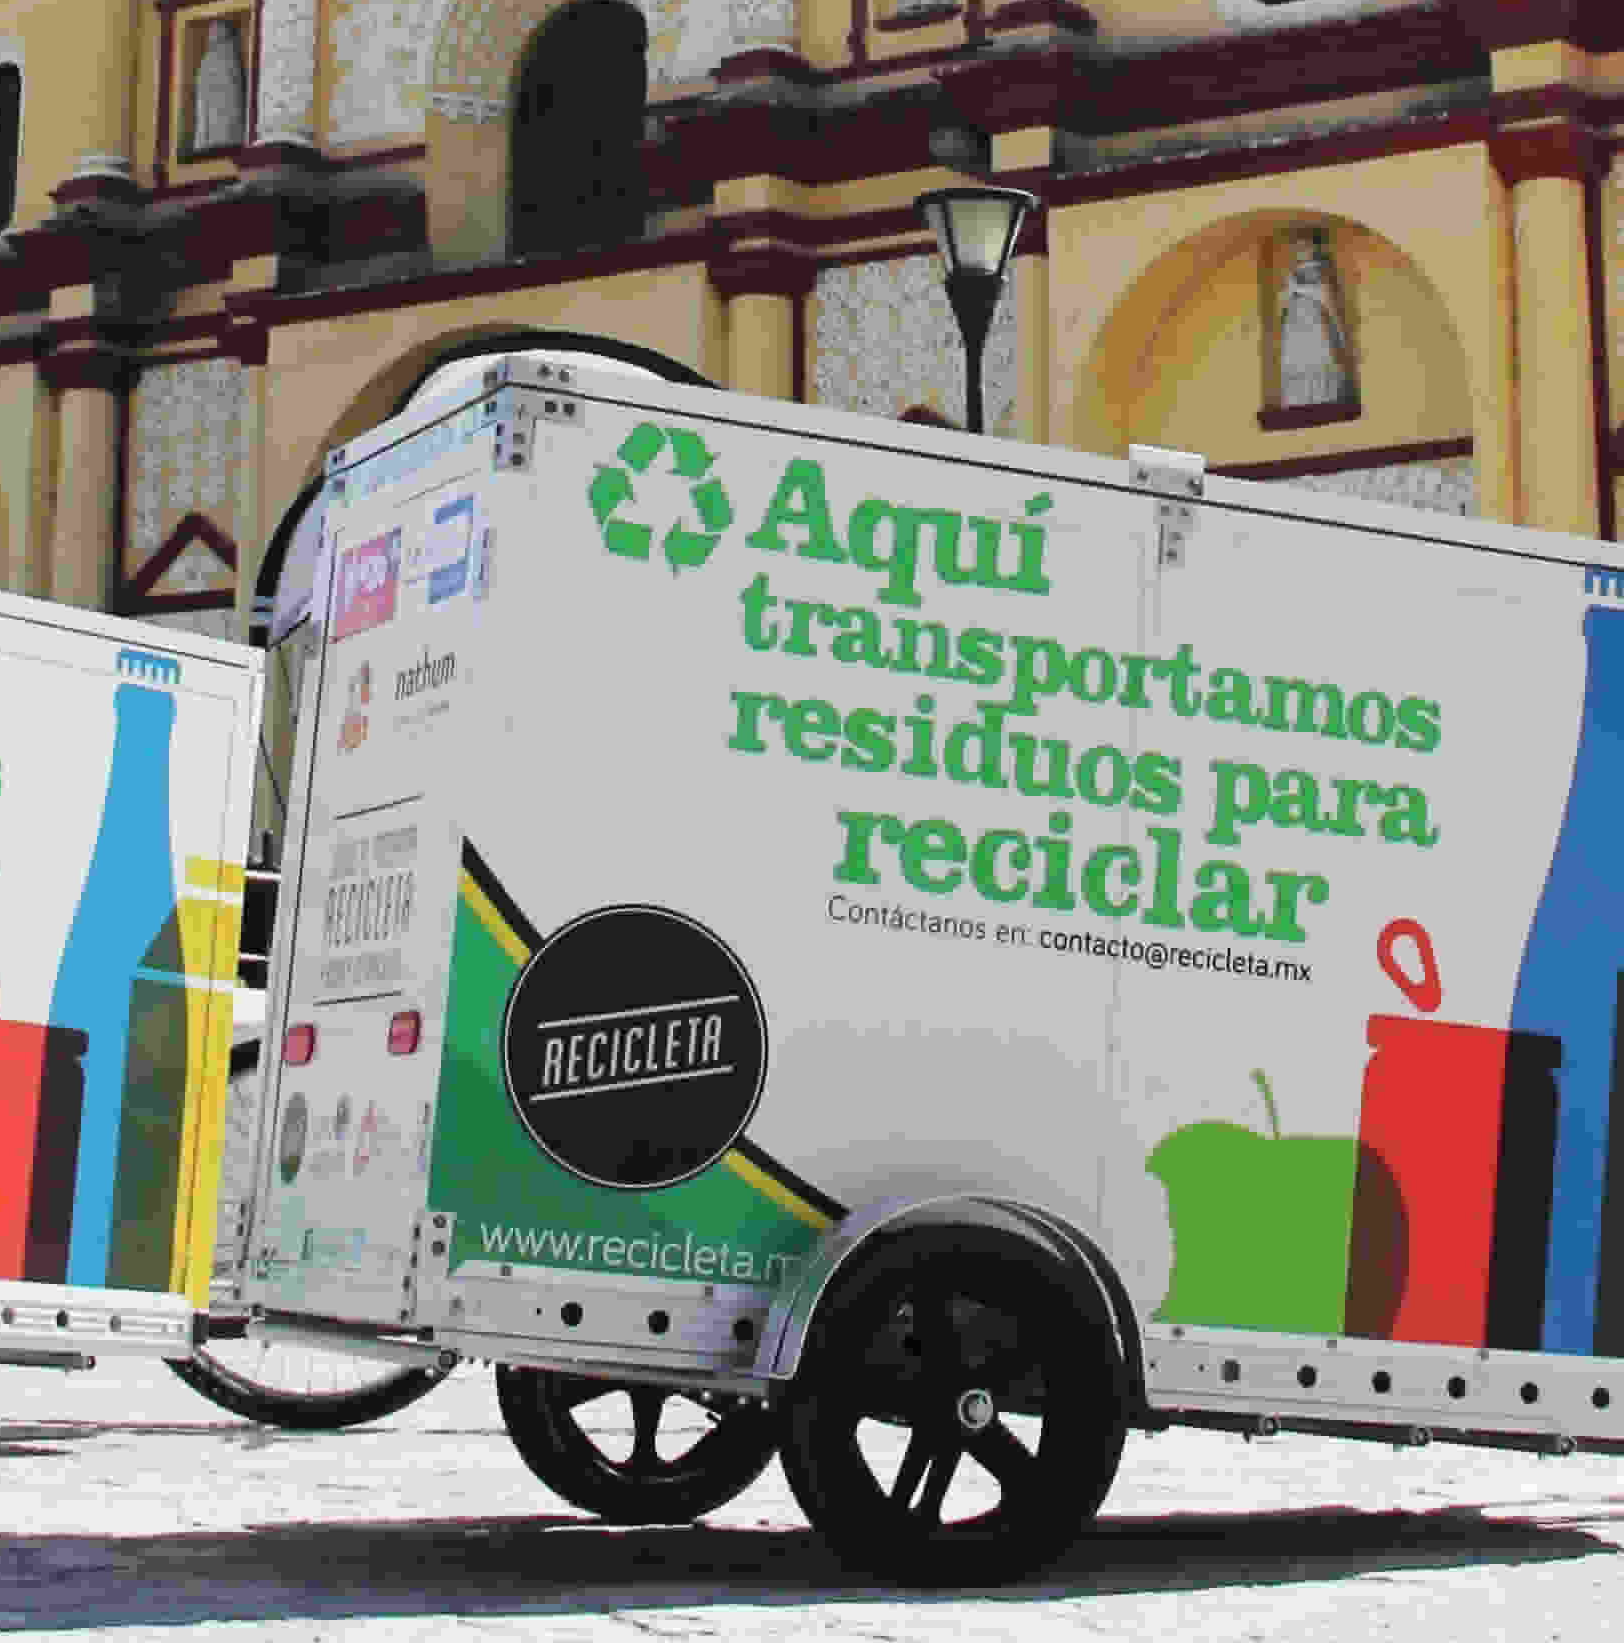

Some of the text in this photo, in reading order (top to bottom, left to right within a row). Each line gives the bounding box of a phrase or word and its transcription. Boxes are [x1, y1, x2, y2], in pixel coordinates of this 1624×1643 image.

[746, 458, 1053, 605] Aquí
[393, 650, 456, 699] nathum
[738, 574, 1443, 754] transportamos
[727, 688, 1440, 847] residuos para
[324, 868, 415, 948] RECICLETA
[831, 806, 1331, 944] reciclar
[827, 893, 986, 940] Contáctanos
[1040, 930, 1313, 982] contacto@recicleta.mx
[541, 1013, 723, 1086] RECICLETA
[480, 1221, 789, 1281] www.recicleta.m
